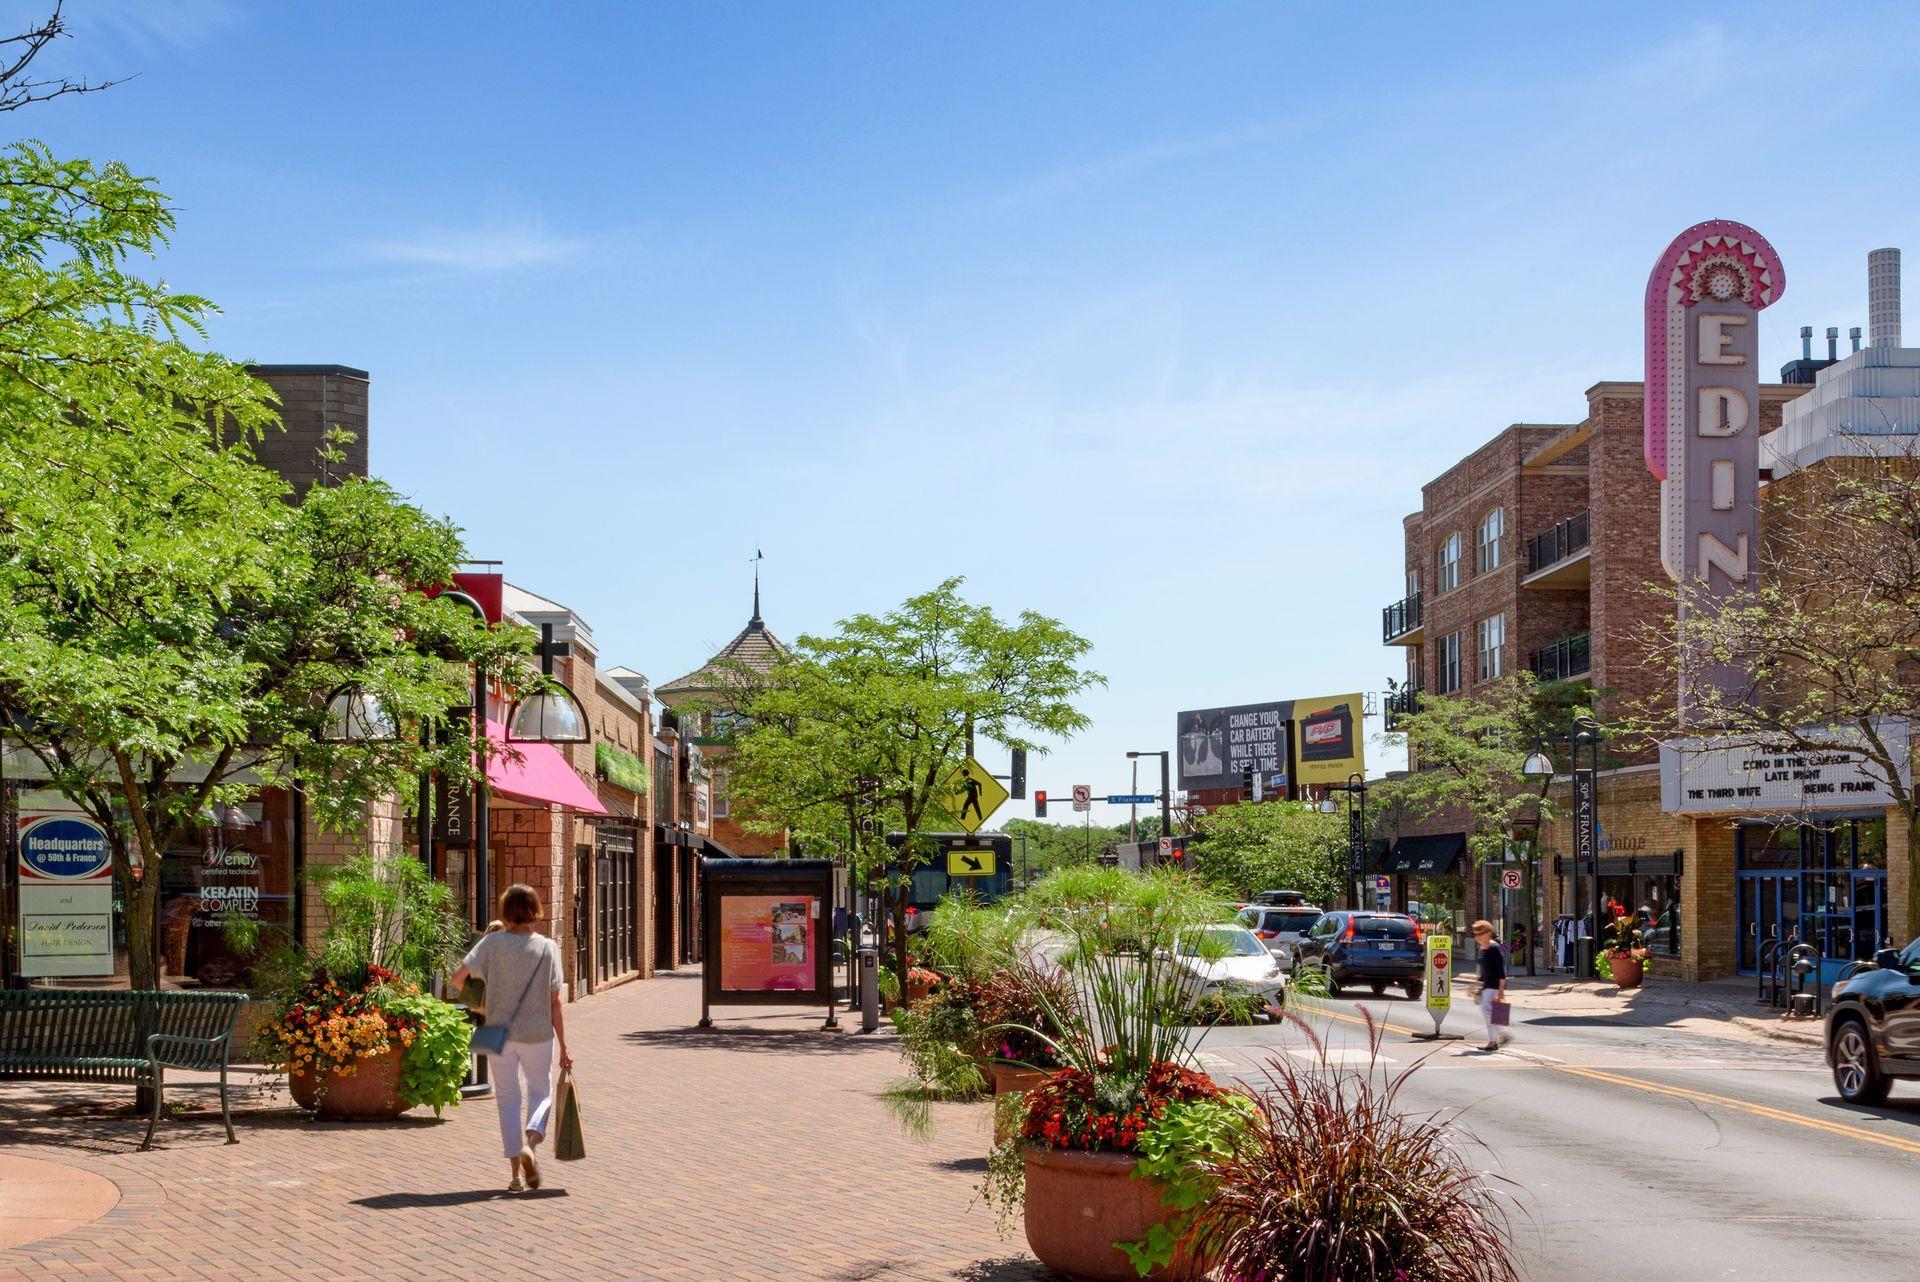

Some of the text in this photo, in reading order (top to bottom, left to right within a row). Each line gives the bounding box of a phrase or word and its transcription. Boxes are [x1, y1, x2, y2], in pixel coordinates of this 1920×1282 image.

[1698, 314, 1748, 655] EDIN
[1230, 710, 1279, 728] CHANGE YOUR
[1230, 726, 1276, 743] CAR BATTERY
[1230, 742, 1277, 758] WHILE THERE
[1230, 760, 1238, 773] IS
[1260, 757, 1280, 771] TIME.
[1774, 758, 1784, 768] IN
[1786, 756, 1806, 767] THE
[1765, 771, 1789, 781] LATE
[1687, 786, 1761, 799] THE THIRD WIFE
[1803, 780, 1876, 794] BEING FRANK
[1579, 782, 1590, 857] 50th & FRANCE
[29, 837, 104, 852] Headquarters
[36, 853, 97, 863] @ 50th & France
[202, 844, 258, 868] Wendy
[201, 887, 259, 898] KERATIN
[59, 896, 73, 904] and
[200, 899, 258, 912] COMPLEX
[1433, 957, 1448, 965] STOP
